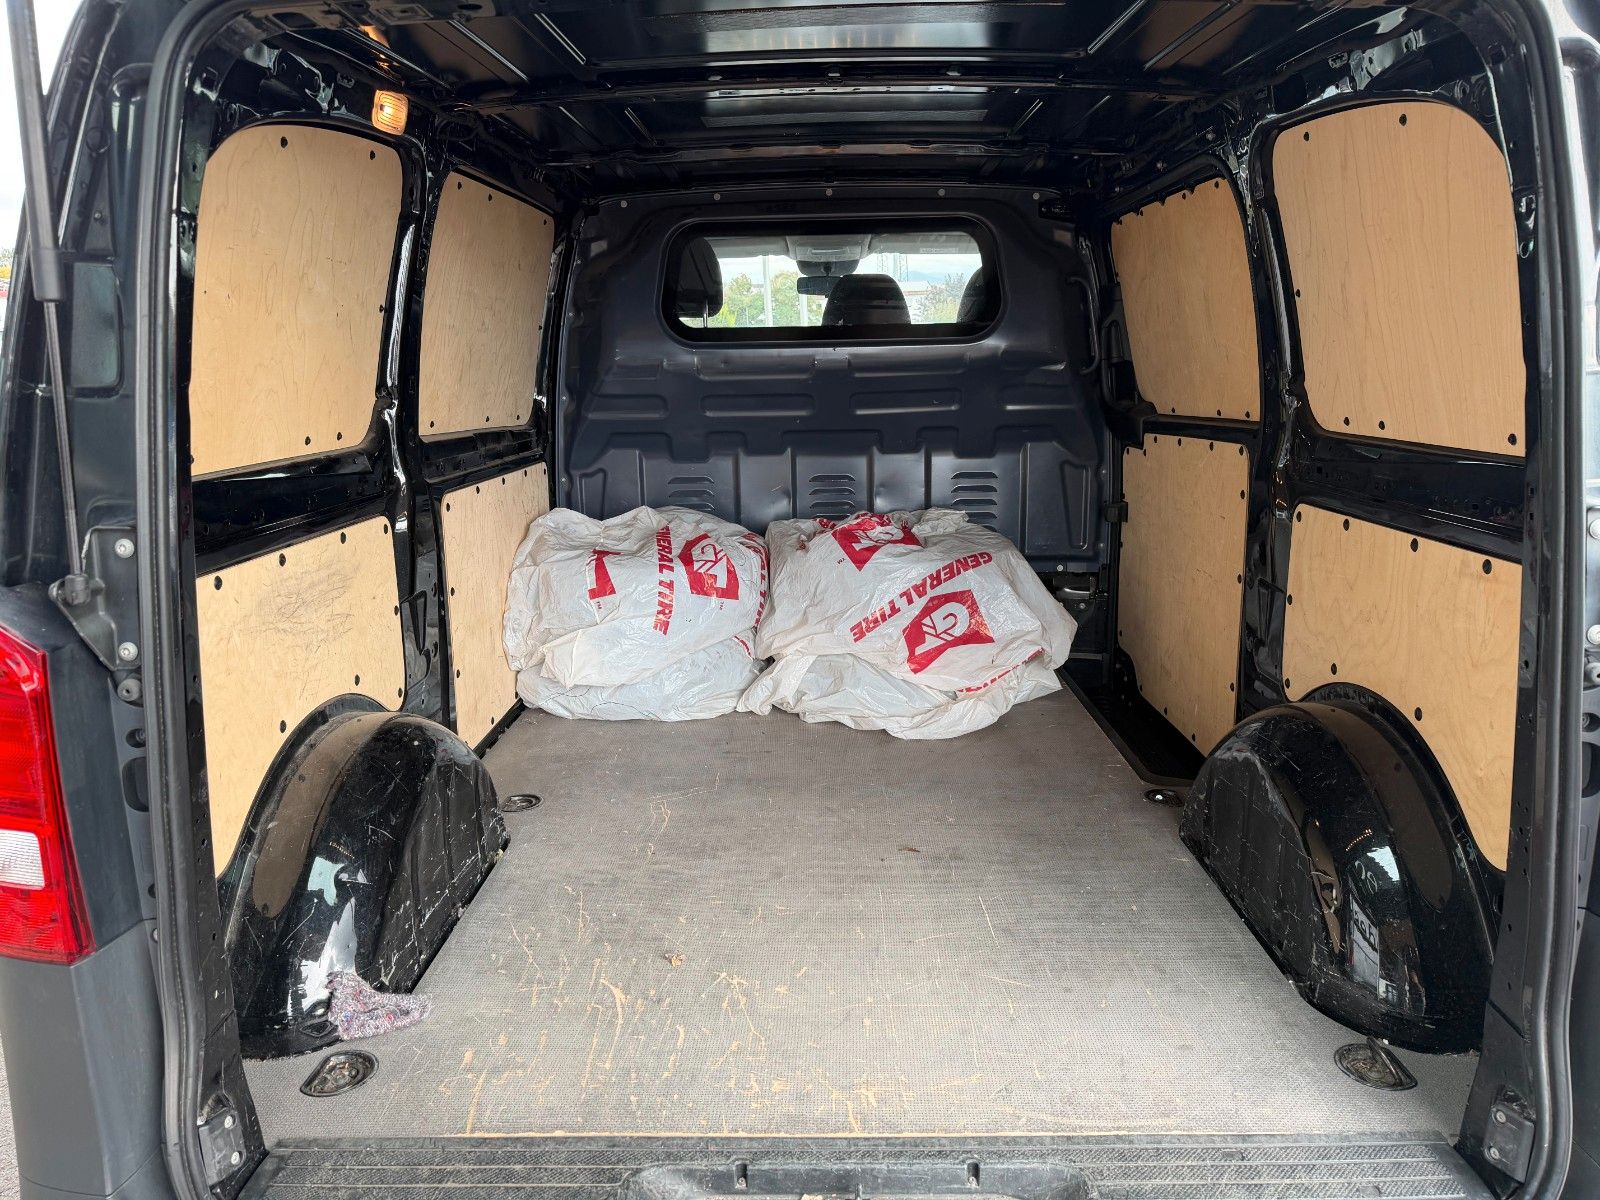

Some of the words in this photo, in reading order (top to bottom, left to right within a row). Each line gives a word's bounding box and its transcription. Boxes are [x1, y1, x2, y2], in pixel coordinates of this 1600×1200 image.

[899, 551, 993, 606] GENERAL
[652, 579, 675, 635] TIRE
[849, 599, 901, 643] TIRE
